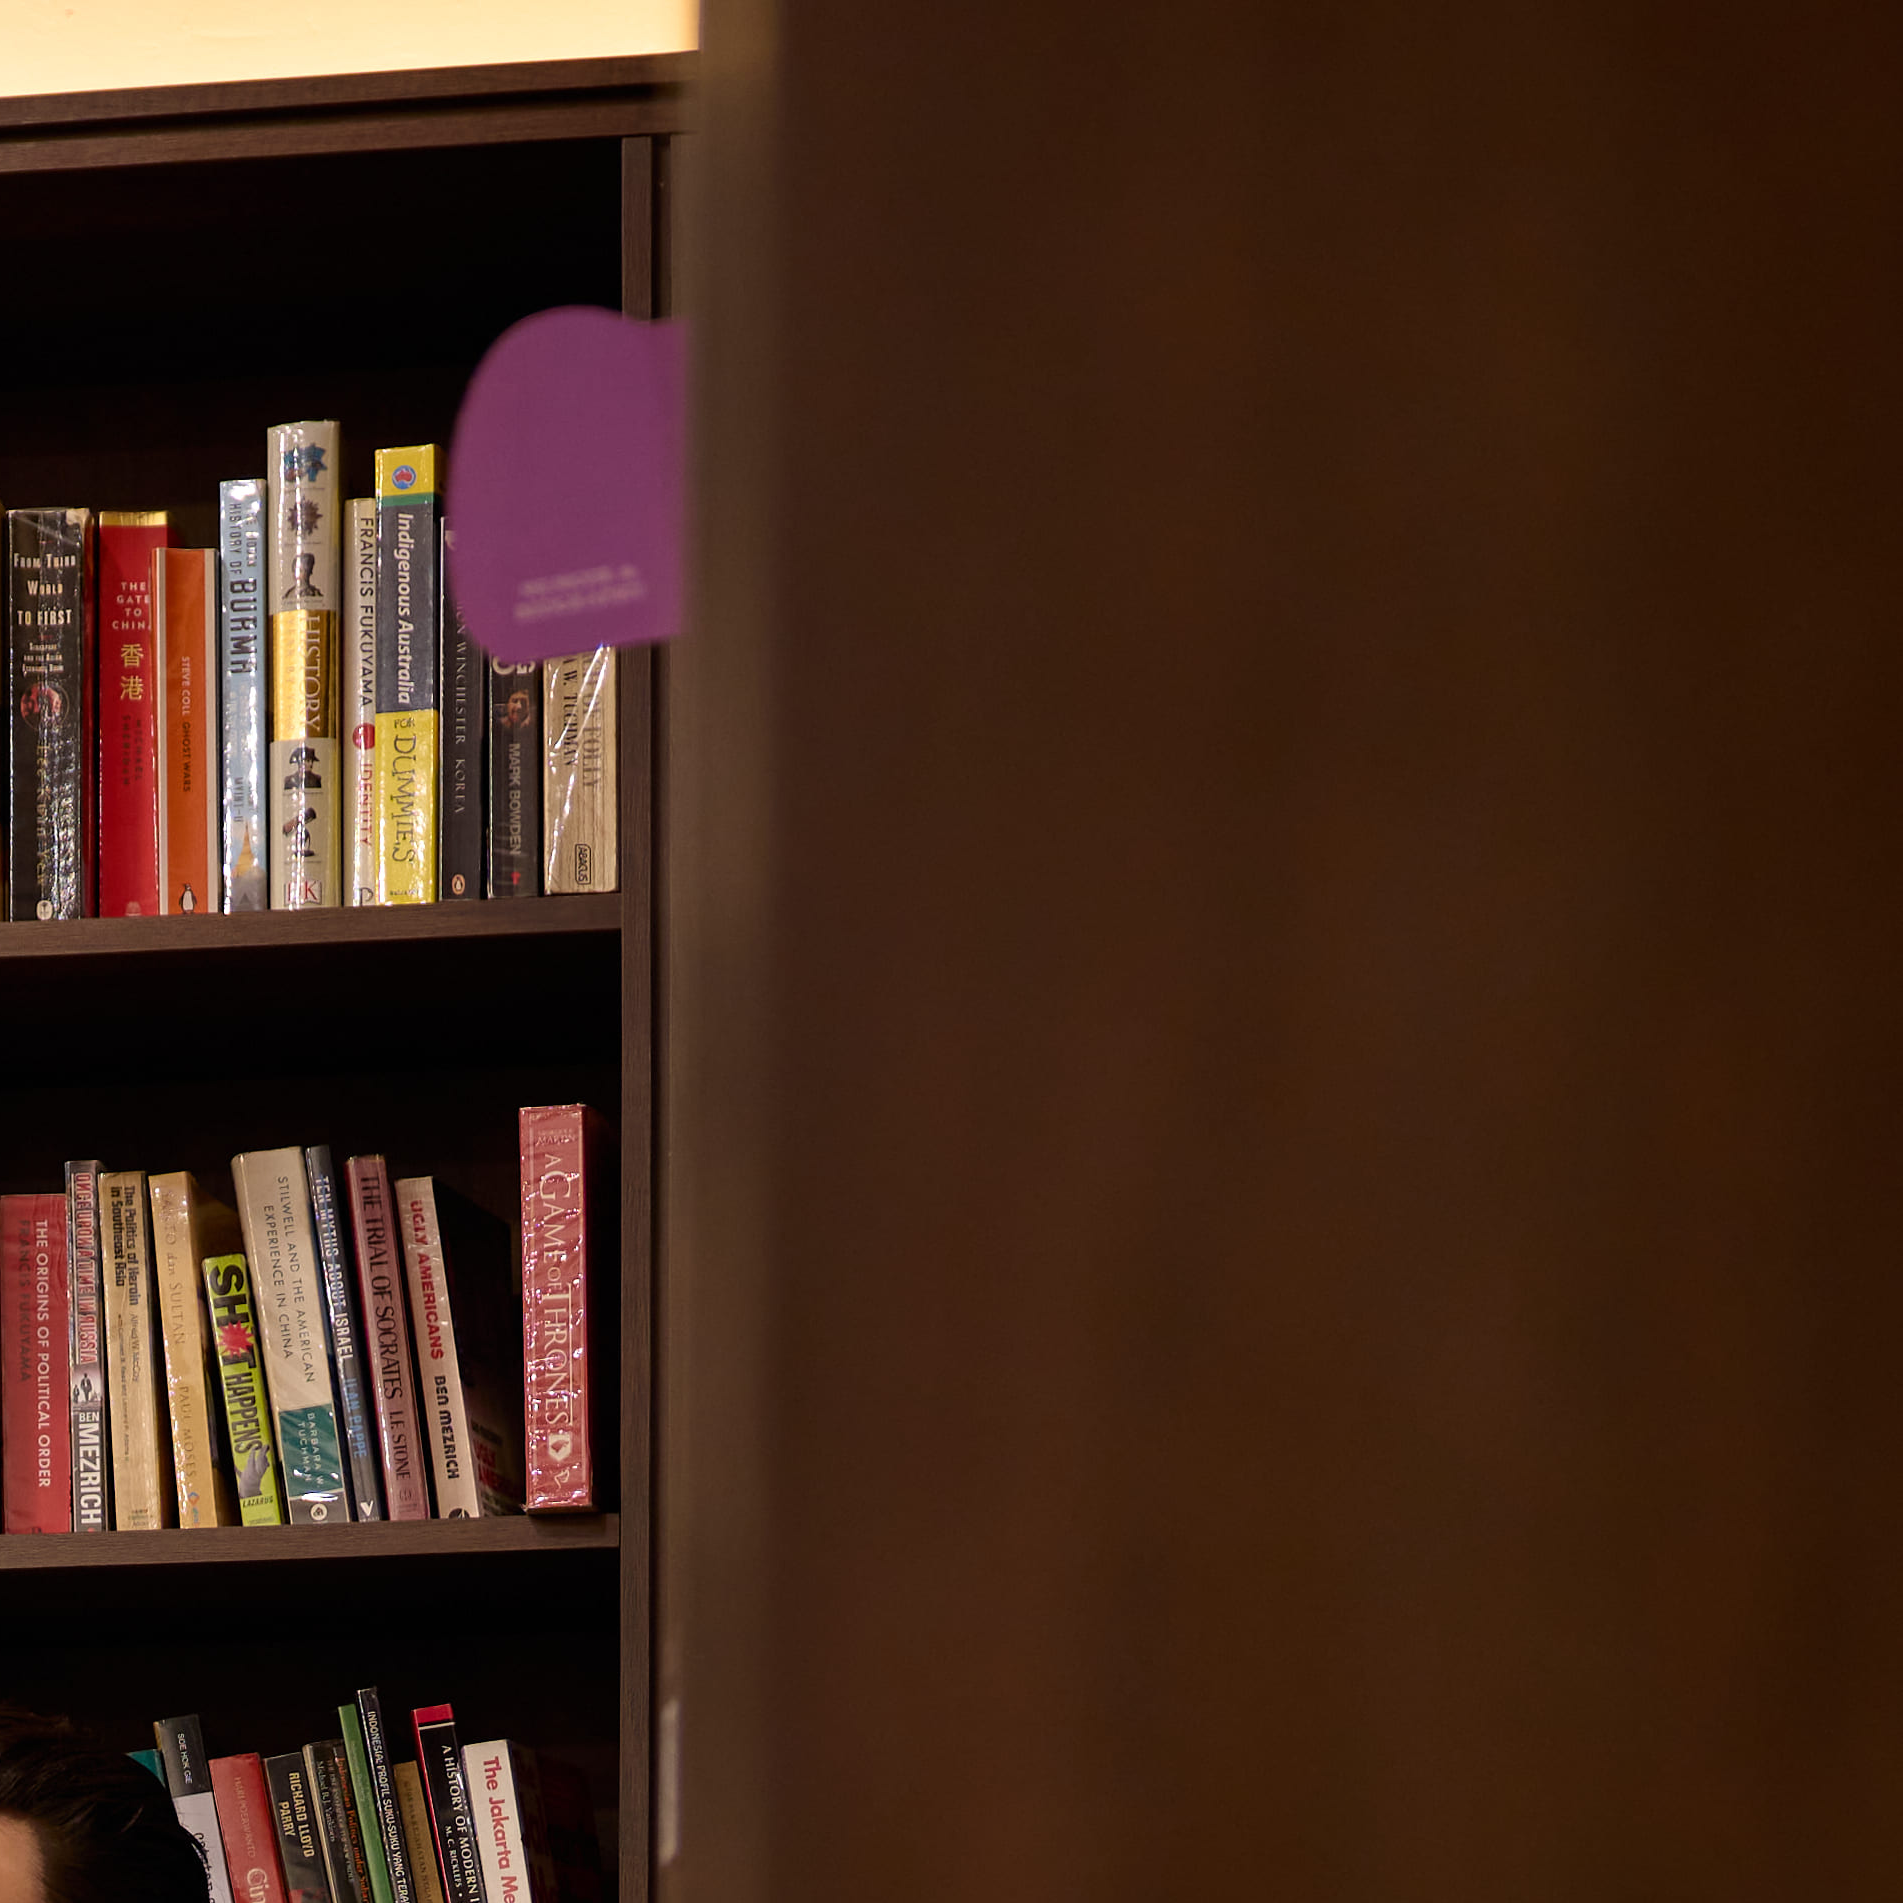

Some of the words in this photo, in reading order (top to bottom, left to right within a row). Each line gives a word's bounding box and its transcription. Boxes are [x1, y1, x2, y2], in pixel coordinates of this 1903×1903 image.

[394, 512, 414, 616] Indigenous
[120, 643, 143, 701] 香港
[181, 656, 191, 686] STEVE
[398, 620, 414, 704] Australia
[181, 689, 191, 715] COLL
[181, 722, 192, 758] GHOST
[182, 762, 192, 792] WARS
[390, 734, 417, 863] DUMMIES
[36, 1220, 48, 1249] THE
[410, 1199, 429, 1246] UGLY
[36, 1253, 49, 1320] ORIGINS
[417, 1253, 444, 1360] AMERICANS
[37, 1326, 49, 1349] OF
[37, 1353, 51, 1429] POLITICAL
[434, 1375, 449, 1405] BEN
[38, 1434, 51, 1487] ORDER
[438, 1410, 459, 1479] MEZRICH
[483, 1757, 501, 1791] The
[488, 1796, 513, 1870] Jakarta
